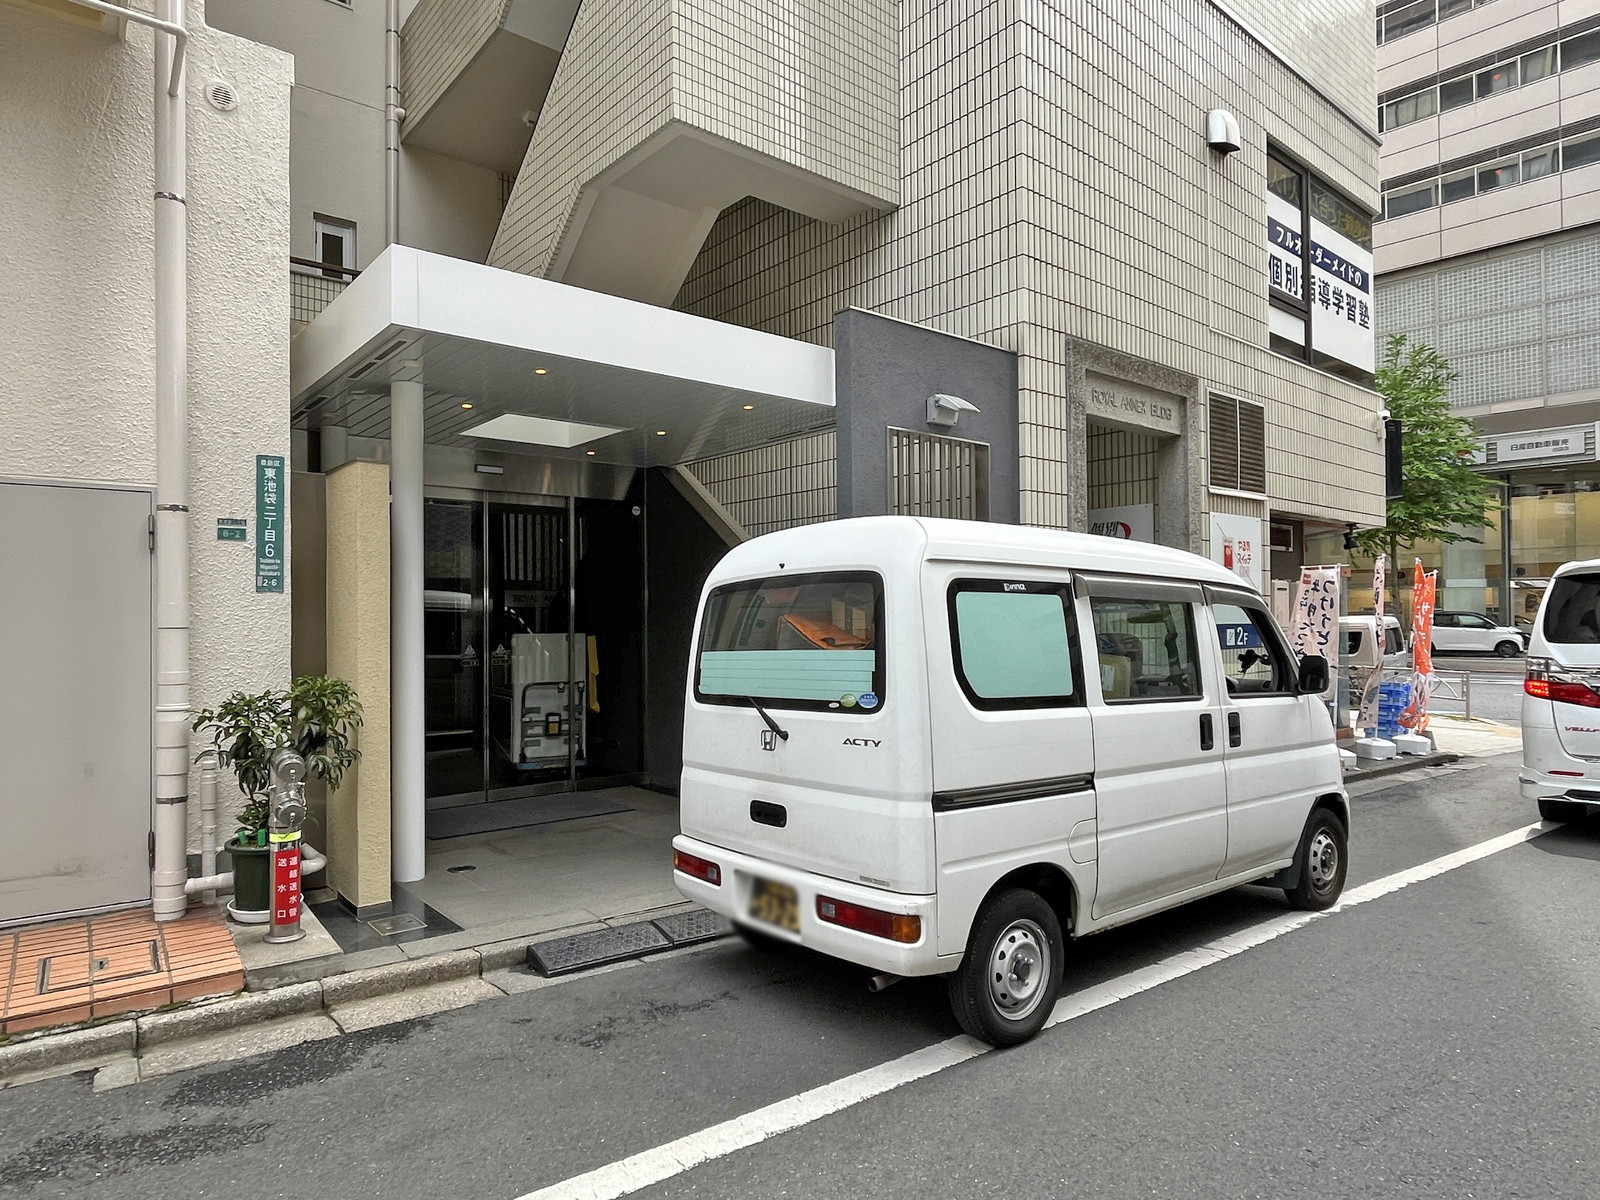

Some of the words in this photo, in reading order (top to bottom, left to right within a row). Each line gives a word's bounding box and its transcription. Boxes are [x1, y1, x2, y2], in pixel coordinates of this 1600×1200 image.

[1091, 388, 1117, 407] ROYAL
[1121, 396, 1147, 416] ANNEX
[222, 529, 241, 539] 6-2
[1236, 627, 1249, 645] 2F
[843, 737, 882, 748] ACTY
[278, 858, 287, 918] 送水口
